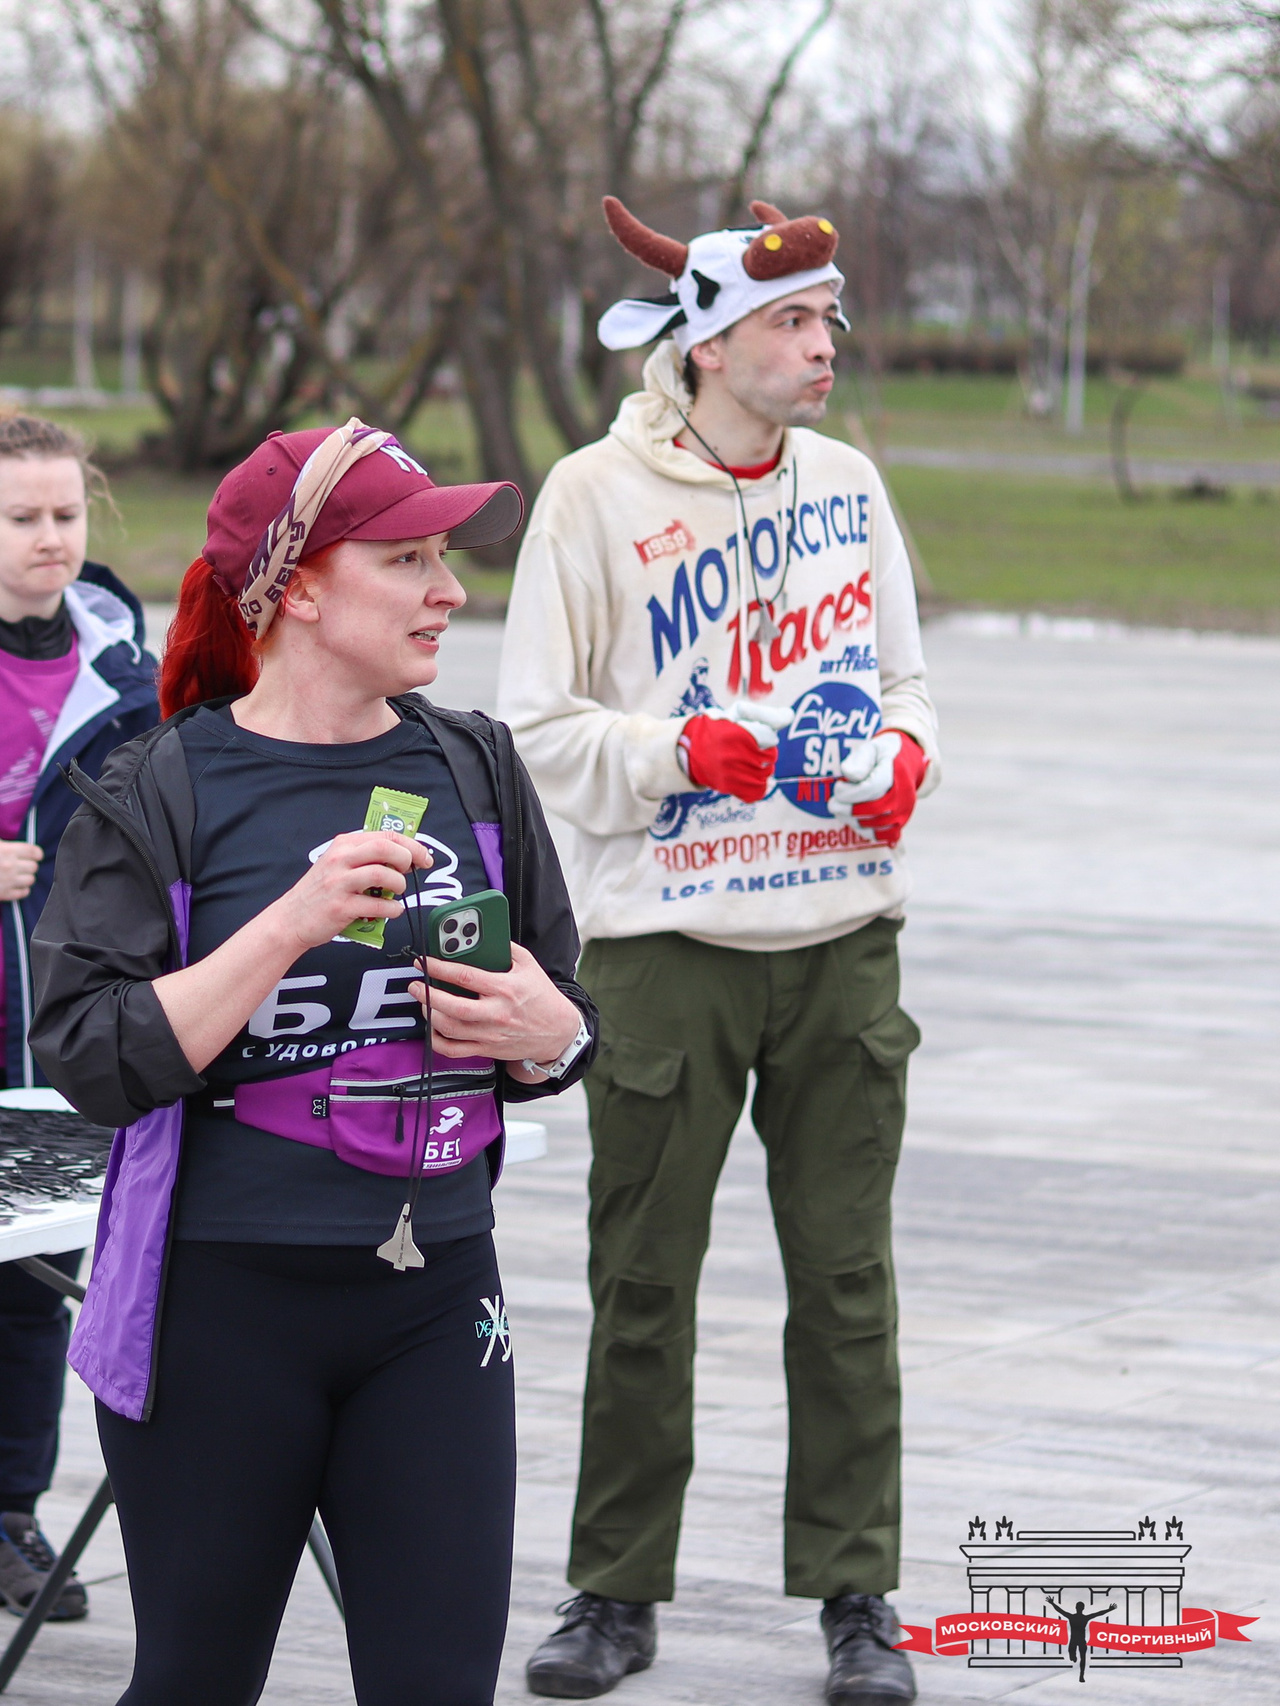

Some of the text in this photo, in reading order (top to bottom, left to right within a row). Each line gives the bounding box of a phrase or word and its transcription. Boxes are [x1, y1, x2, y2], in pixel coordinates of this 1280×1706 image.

[643, 529, 688, 560] 1958
[727, 569, 872, 700] Races
[787, 692, 881, 741] Every
[796, 775, 835, 803] NIT
[655, 824, 872, 873] ROCKPORT speed
[661, 860, 893, 901] LOS ANGELES US
[248, 966, 426, 1039] БЕ
